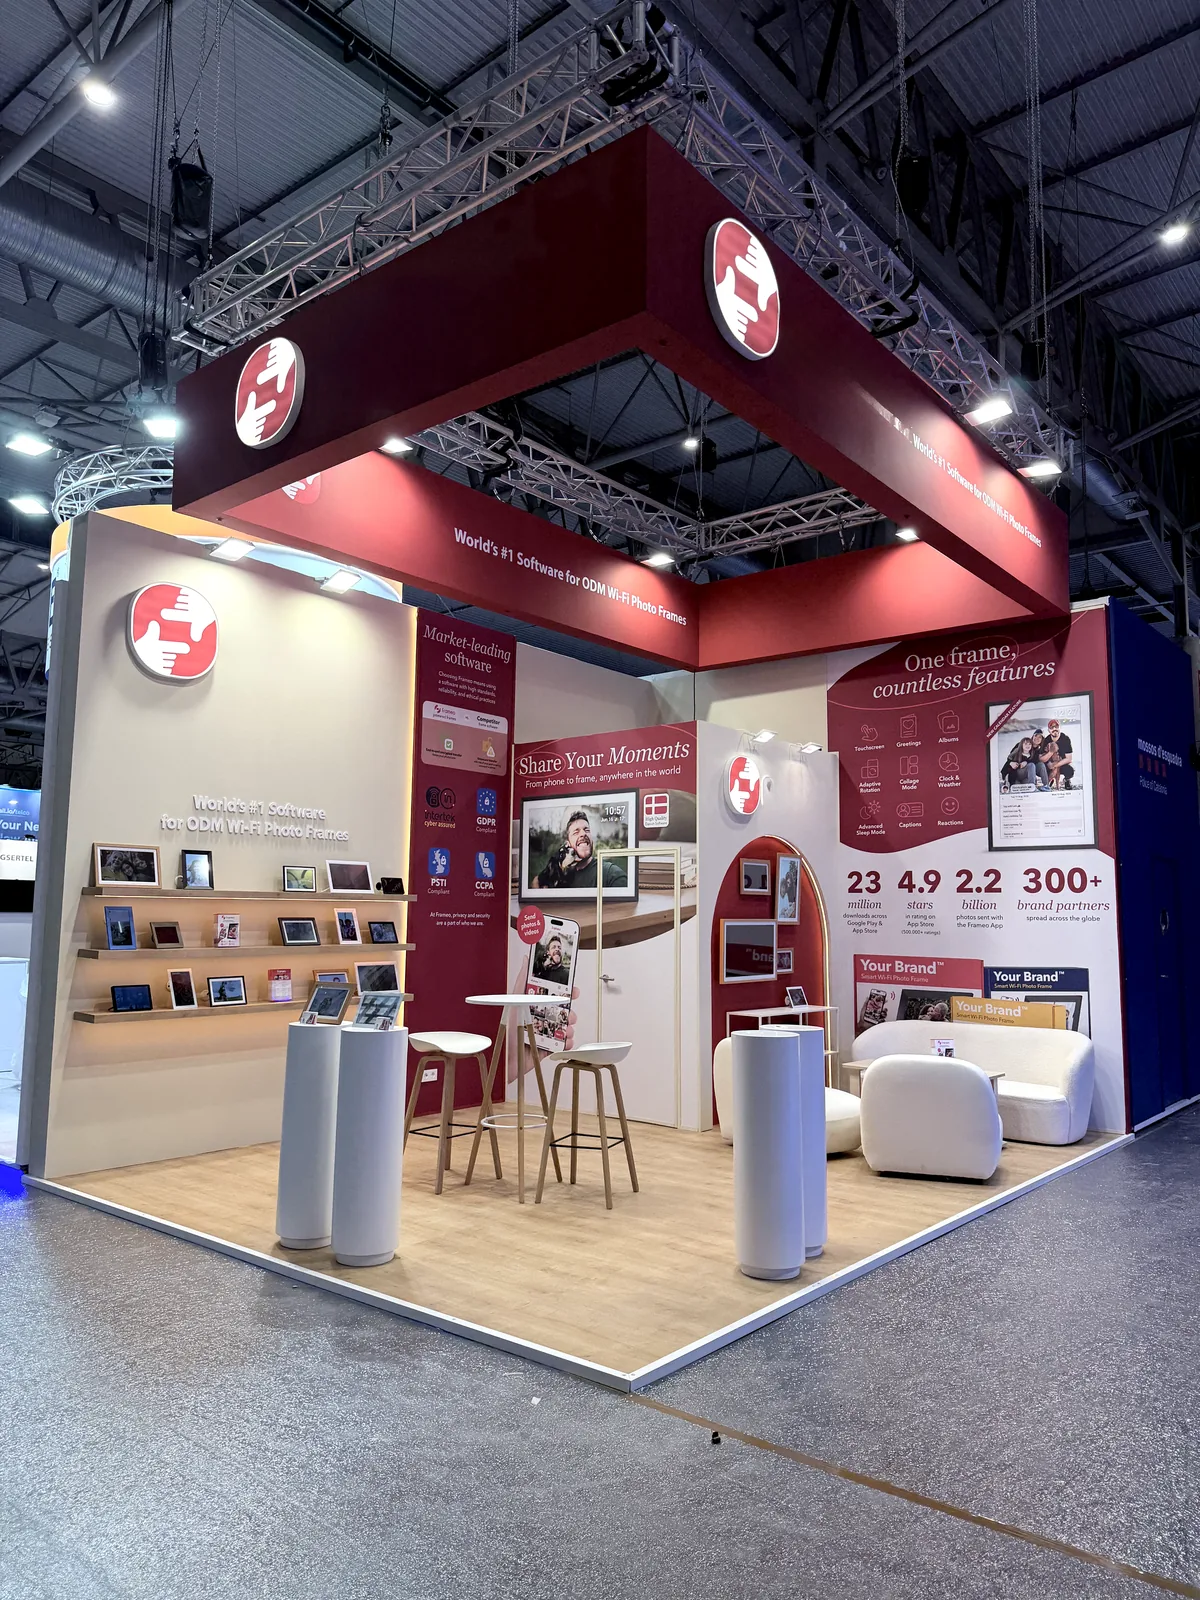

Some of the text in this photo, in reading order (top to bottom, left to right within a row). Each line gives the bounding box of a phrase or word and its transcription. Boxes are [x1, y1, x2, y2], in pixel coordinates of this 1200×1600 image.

[913, 434, 1042, 548] World's #1 Software for ODM Wi-Fi Photo Frames
[454, 527, 687, 626] World's #1 Software for ODM Wi-Fi Photo Frames
[423, 624, 511, 664] Market-leading
[444, 652, 492, 673] software
[905, 644, 1017, 672] One frame,
[438, 670, 458, 680] Choosing
[873, 661, 1056, 699] countless features
[442, 680, 458, 688] software
[476, 716, 500, 725] Competitor
[986, 728, 994, 738] NEW
[1008, 698, 1022, 714] FEATURE
[1138, 738, 1156, 756] mossos
[519, 758, 562, 775] Share
[565, 752, 604, 770] Your
[607, 741, 690, 766] Moments
[526, 780, 542, 788] From
[543, 778, 564, 789] phone
[576, 775, 597, 784] frame,
[599, 771, 634, 784] anywhere
[658, 766, 681, 775] world
[193, 794, 326, 820] World's #1 Software
[605, 805, 626, 815] 10:57
[424, 810, 455, 822] intertek
[476, 816, 496, 826] GDPR
[160, 813, 349, 842] for ODM Wi-Fi Photo Frames
[431, 878, 447, 887] PSTI
[475, 881, 494, 889] CCPA
[848, 867, 1102, 894] 23 4.9 2.2 300+
[848, 900, 1110, 913] million stars billion brand partners
[524, 912, 536, 921] Send
[521, 921, 537, 931] photos
[860, 959, 891, 972] Your
[993, 971, 1021, 981] Your
[956, 1000, 982, 1012] Your
